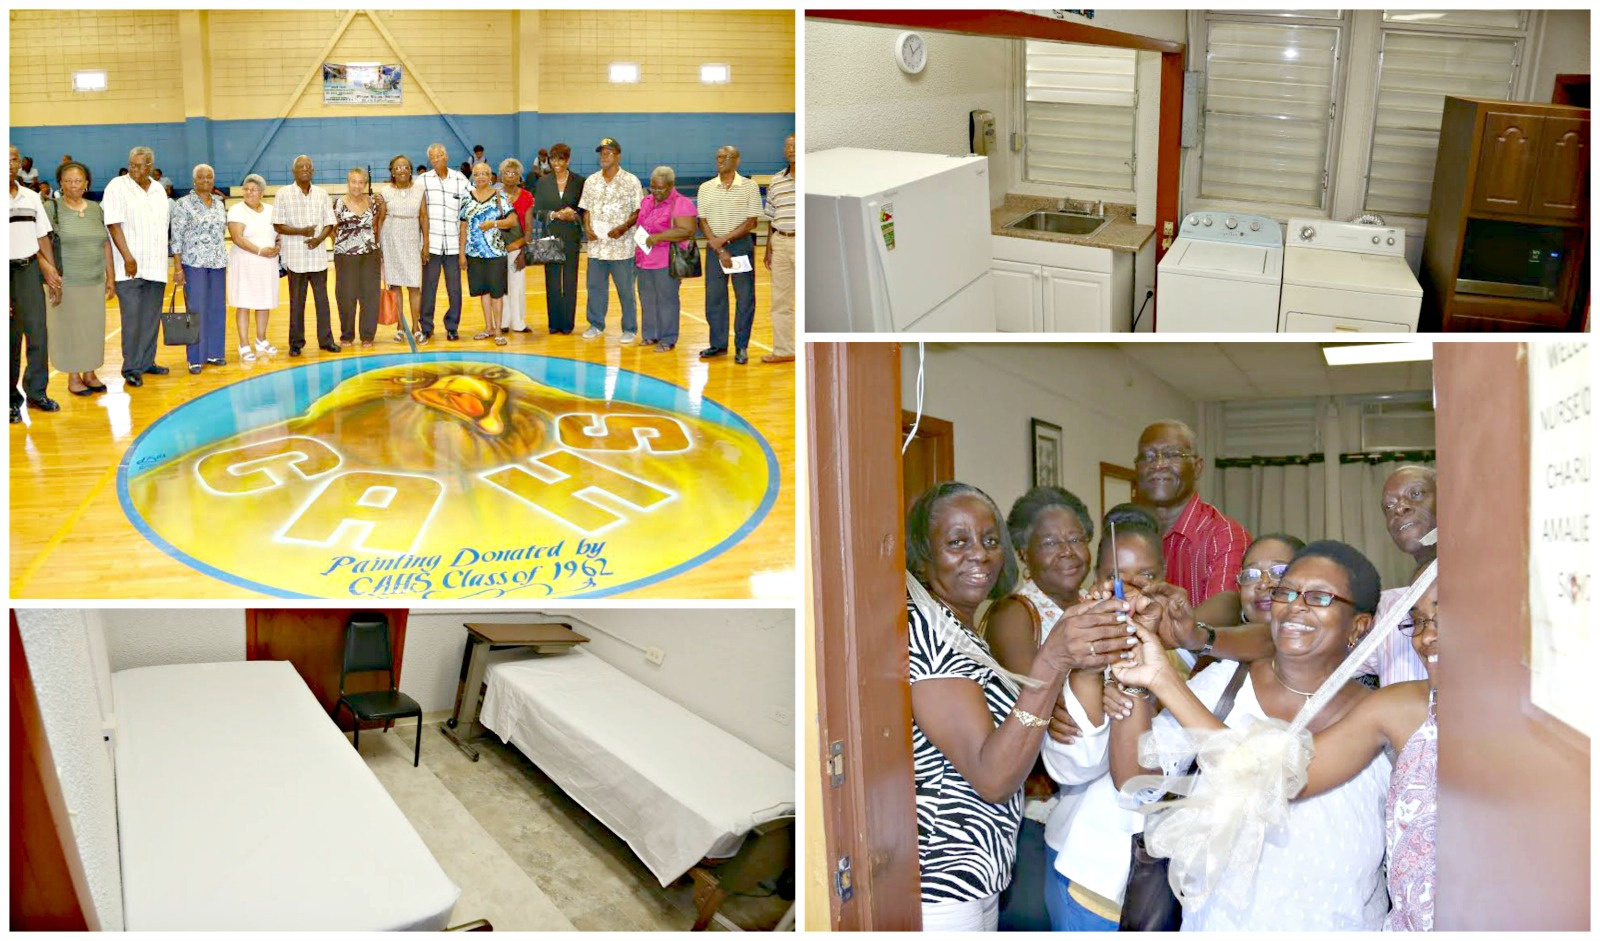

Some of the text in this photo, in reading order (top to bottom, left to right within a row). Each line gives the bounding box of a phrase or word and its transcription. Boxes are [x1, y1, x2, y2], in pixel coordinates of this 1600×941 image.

[1546, 455, 1591, 489] CHARL
[320, 538, 606, 576] Painting Donated by
[348, 572, 433, 597] CAHS
[441, 569, 514, 589] Class
[553, 557, 615, 581] 1962
